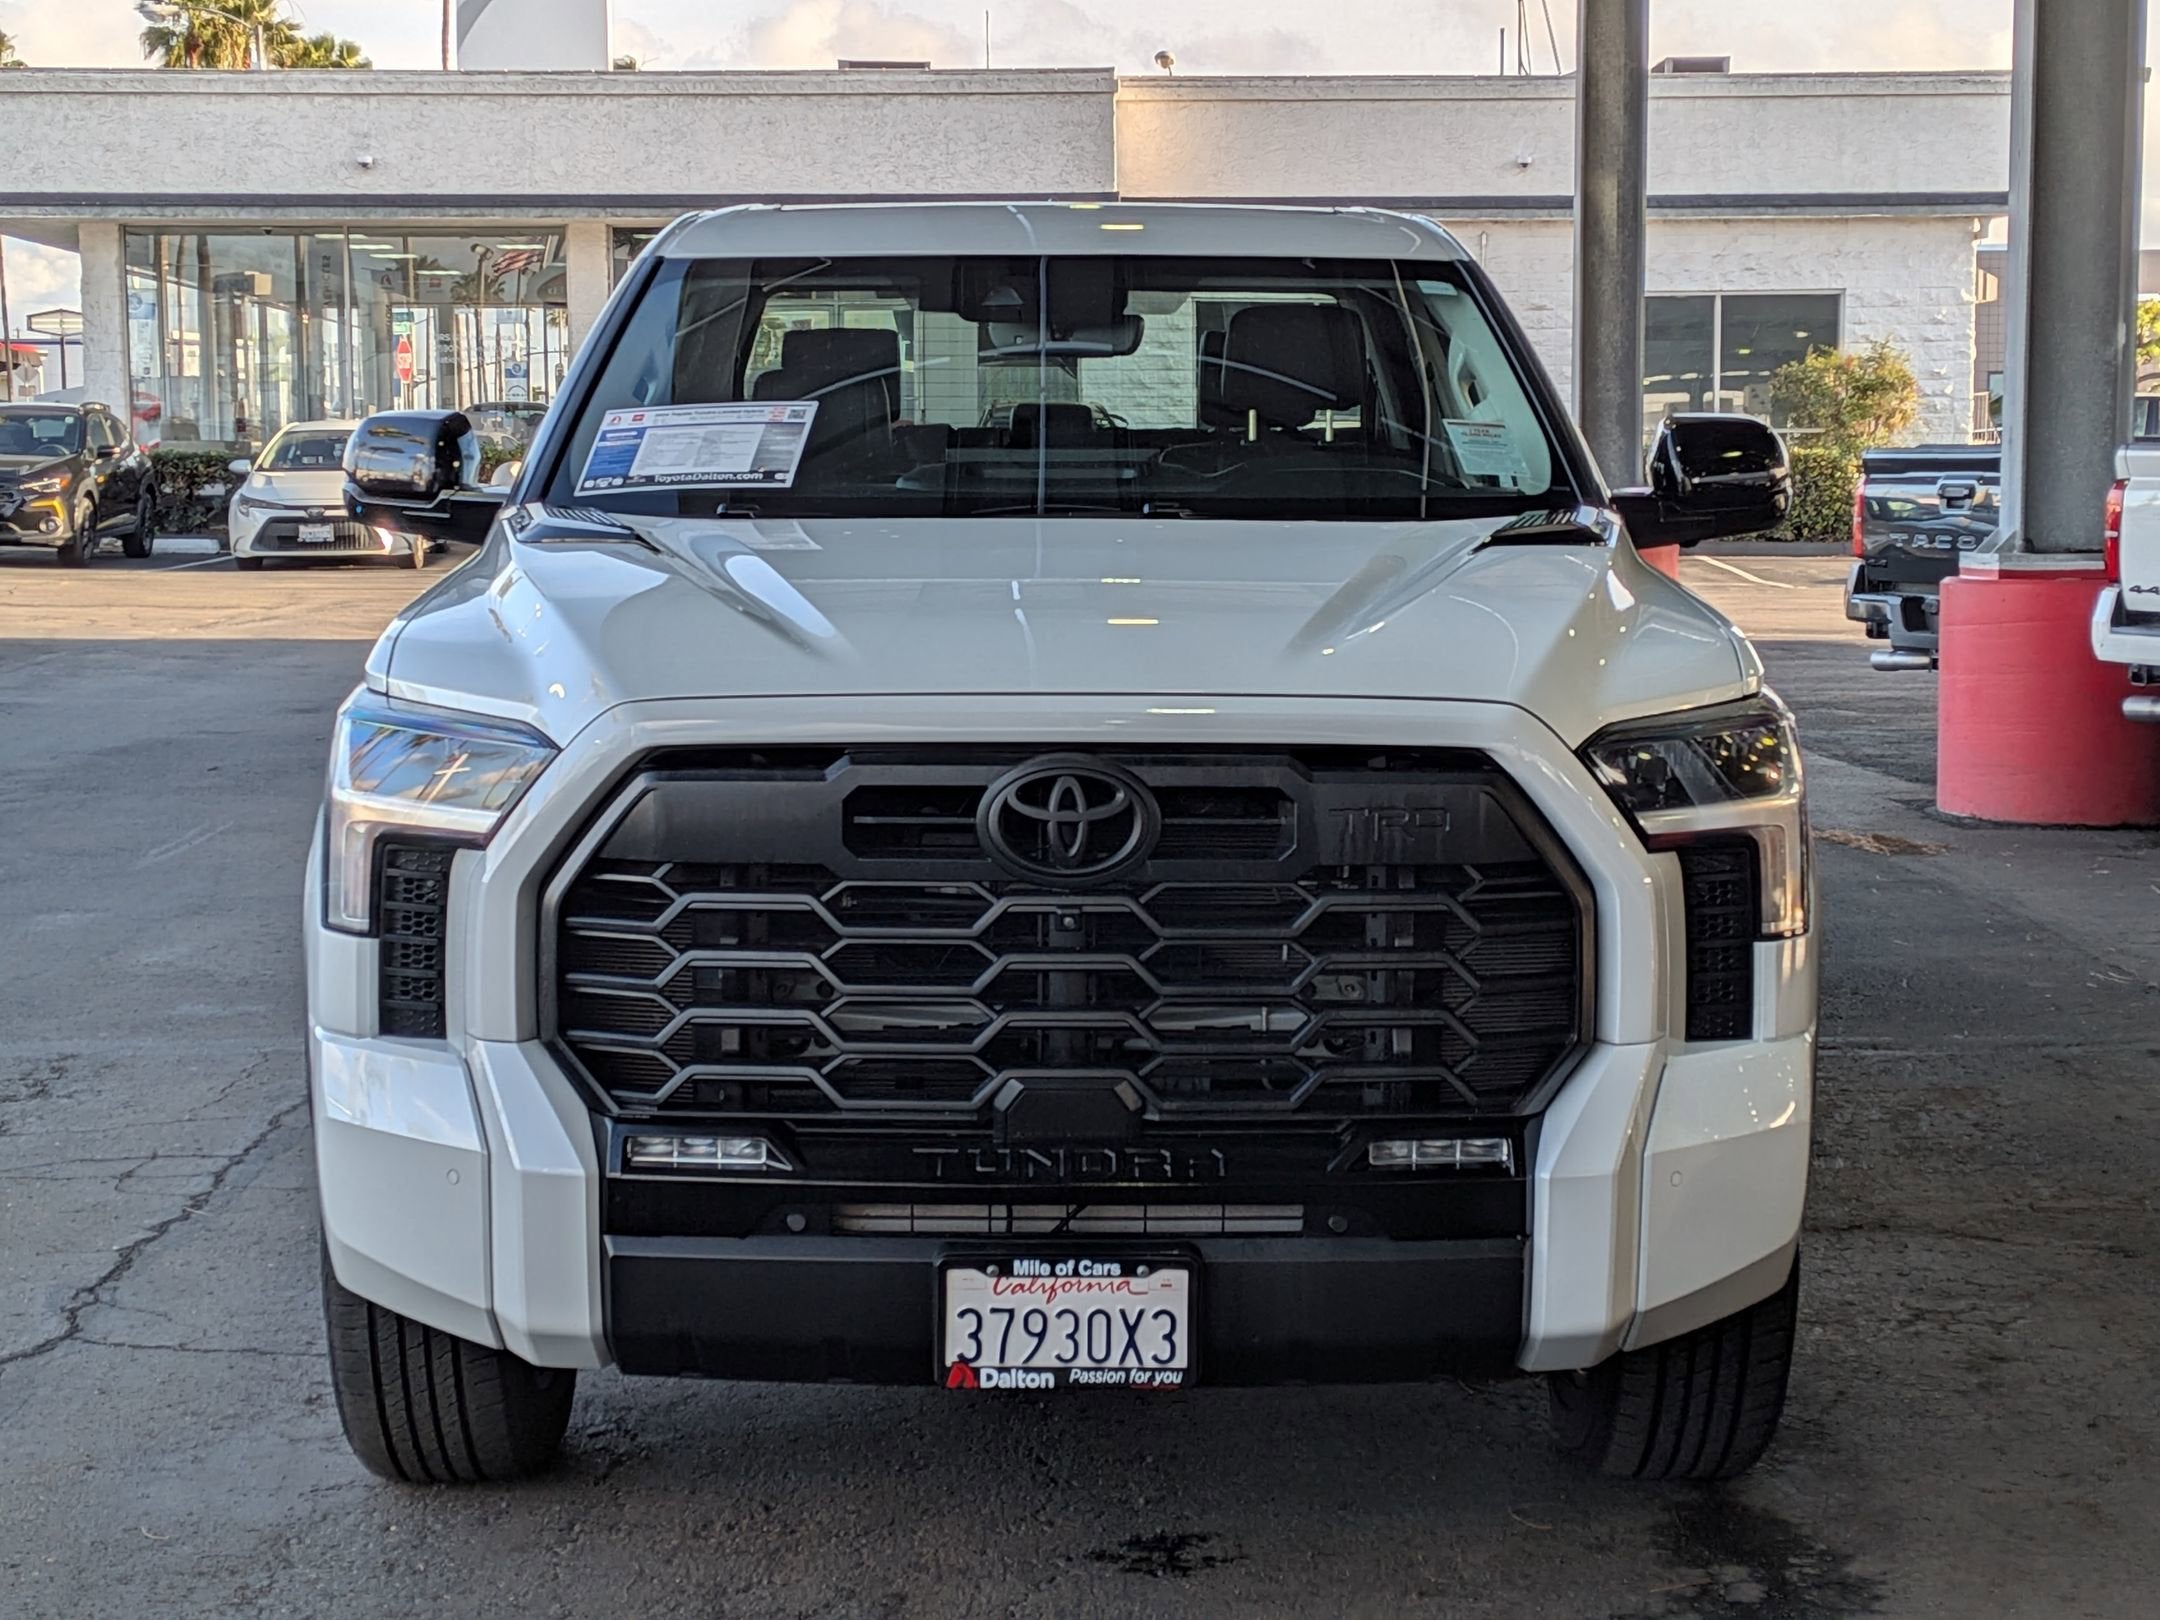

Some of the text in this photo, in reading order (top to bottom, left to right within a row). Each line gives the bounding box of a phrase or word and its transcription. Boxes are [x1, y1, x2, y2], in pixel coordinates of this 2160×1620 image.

[1889, 532, 1988, 549] TACO
[912, 1148, 1226, 1177] TUNDRA
[1012, 1259, 1122, 1277] Mile of Cars
[992, 1276, 1149, 1305] California
[956, 1306, 1178, 1366] 37930X3
[979, 1368, 1056, 1390] Dalton
[1069, 1368, 1183, 1387] Passion for you
